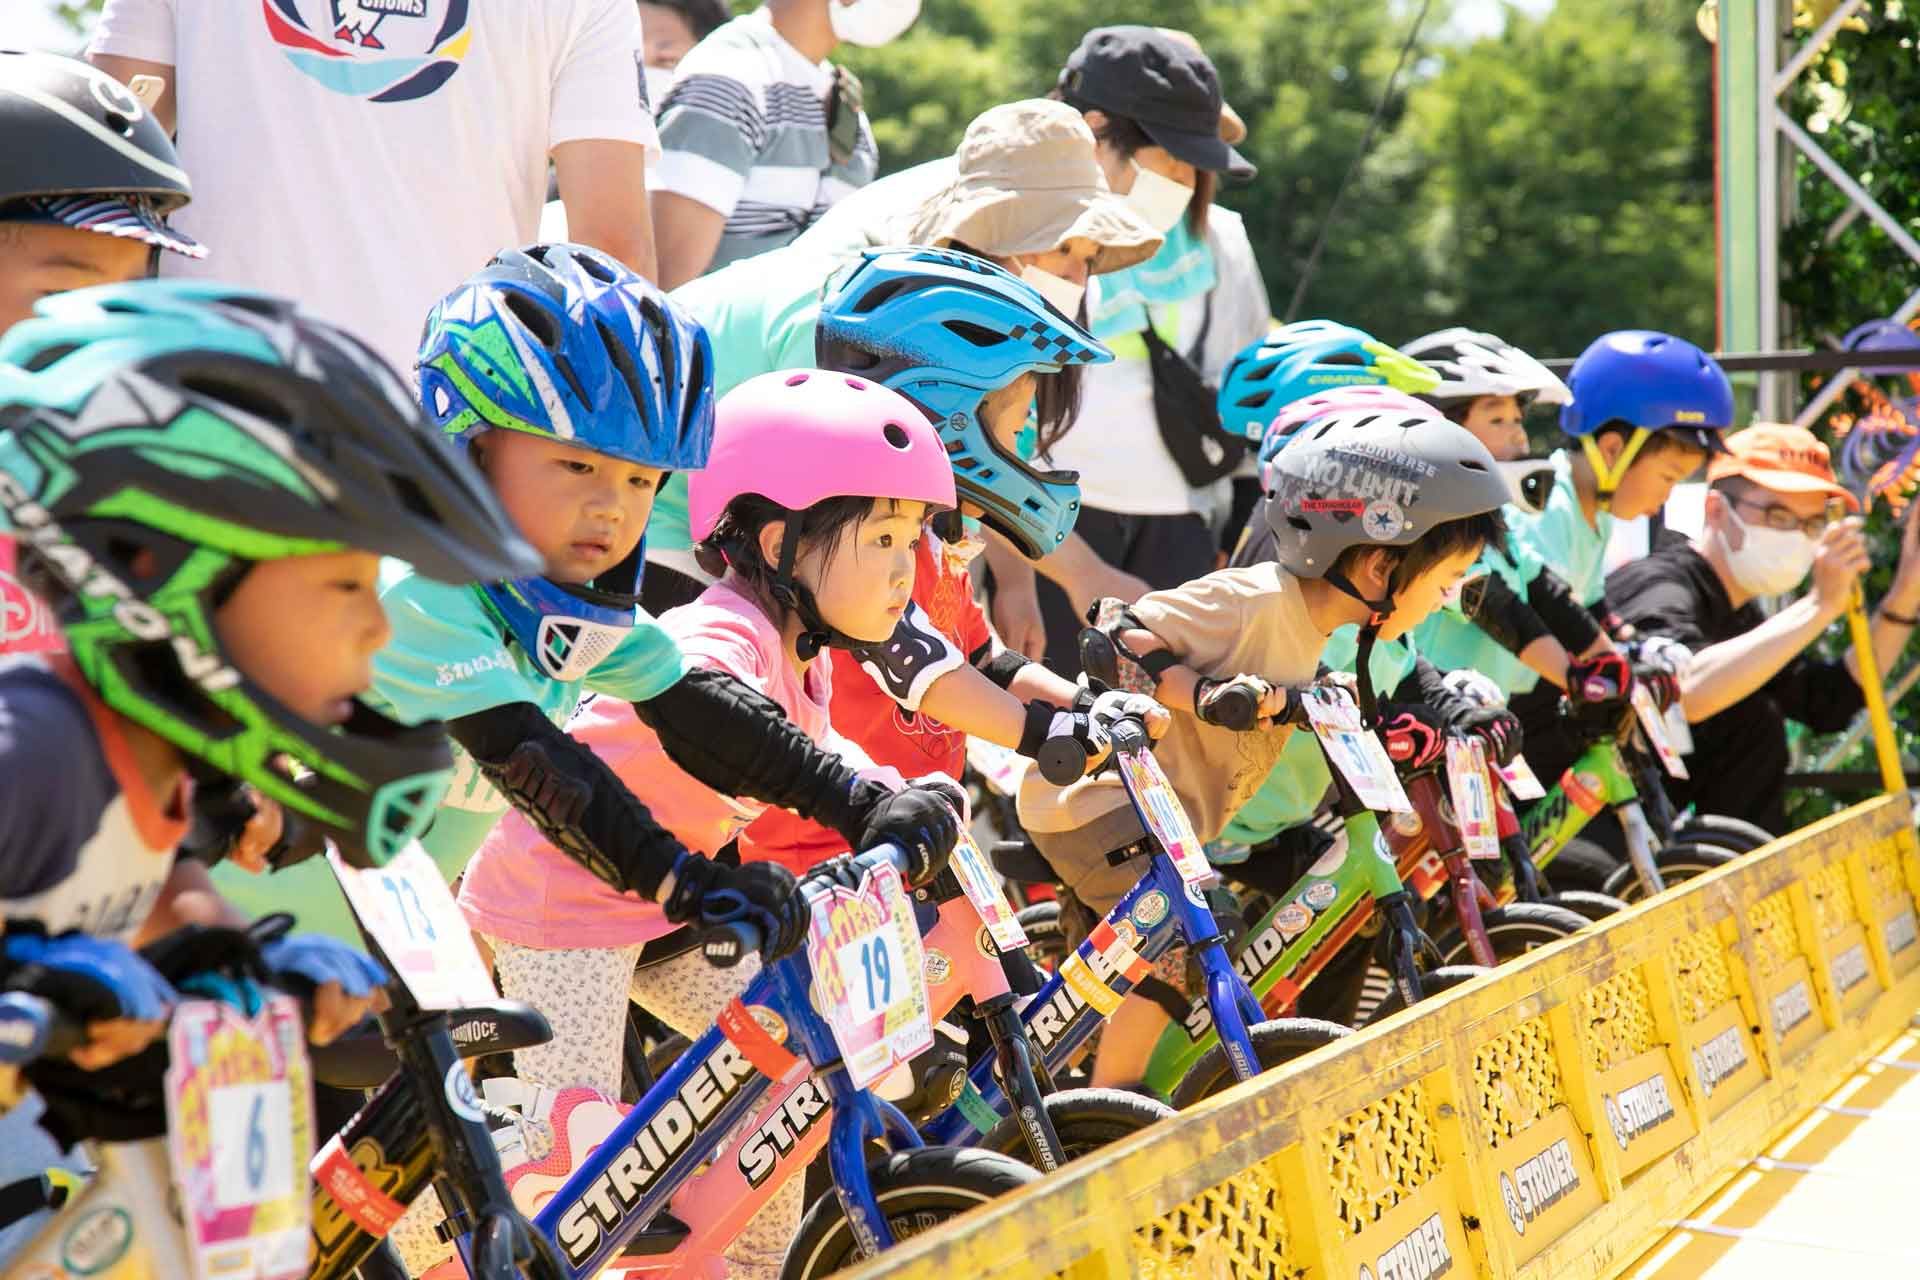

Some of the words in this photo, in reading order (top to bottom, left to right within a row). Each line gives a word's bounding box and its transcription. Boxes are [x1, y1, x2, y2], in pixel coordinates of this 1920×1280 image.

[1302, 454, 1344, 488] NO
[1343, 465, 1422, 508] LIMIT
[861, 935, 892, 1010] 19
[1702, 1024, 1749, 1088] STRIDER
[245, 1093, 270, 1193] 6
[1615, 1072, 1675, 1140] STRIDER
[556, 1039, 756, 1267] STRIDER
[1514, 1137, 1581, 1223] STRIDER
